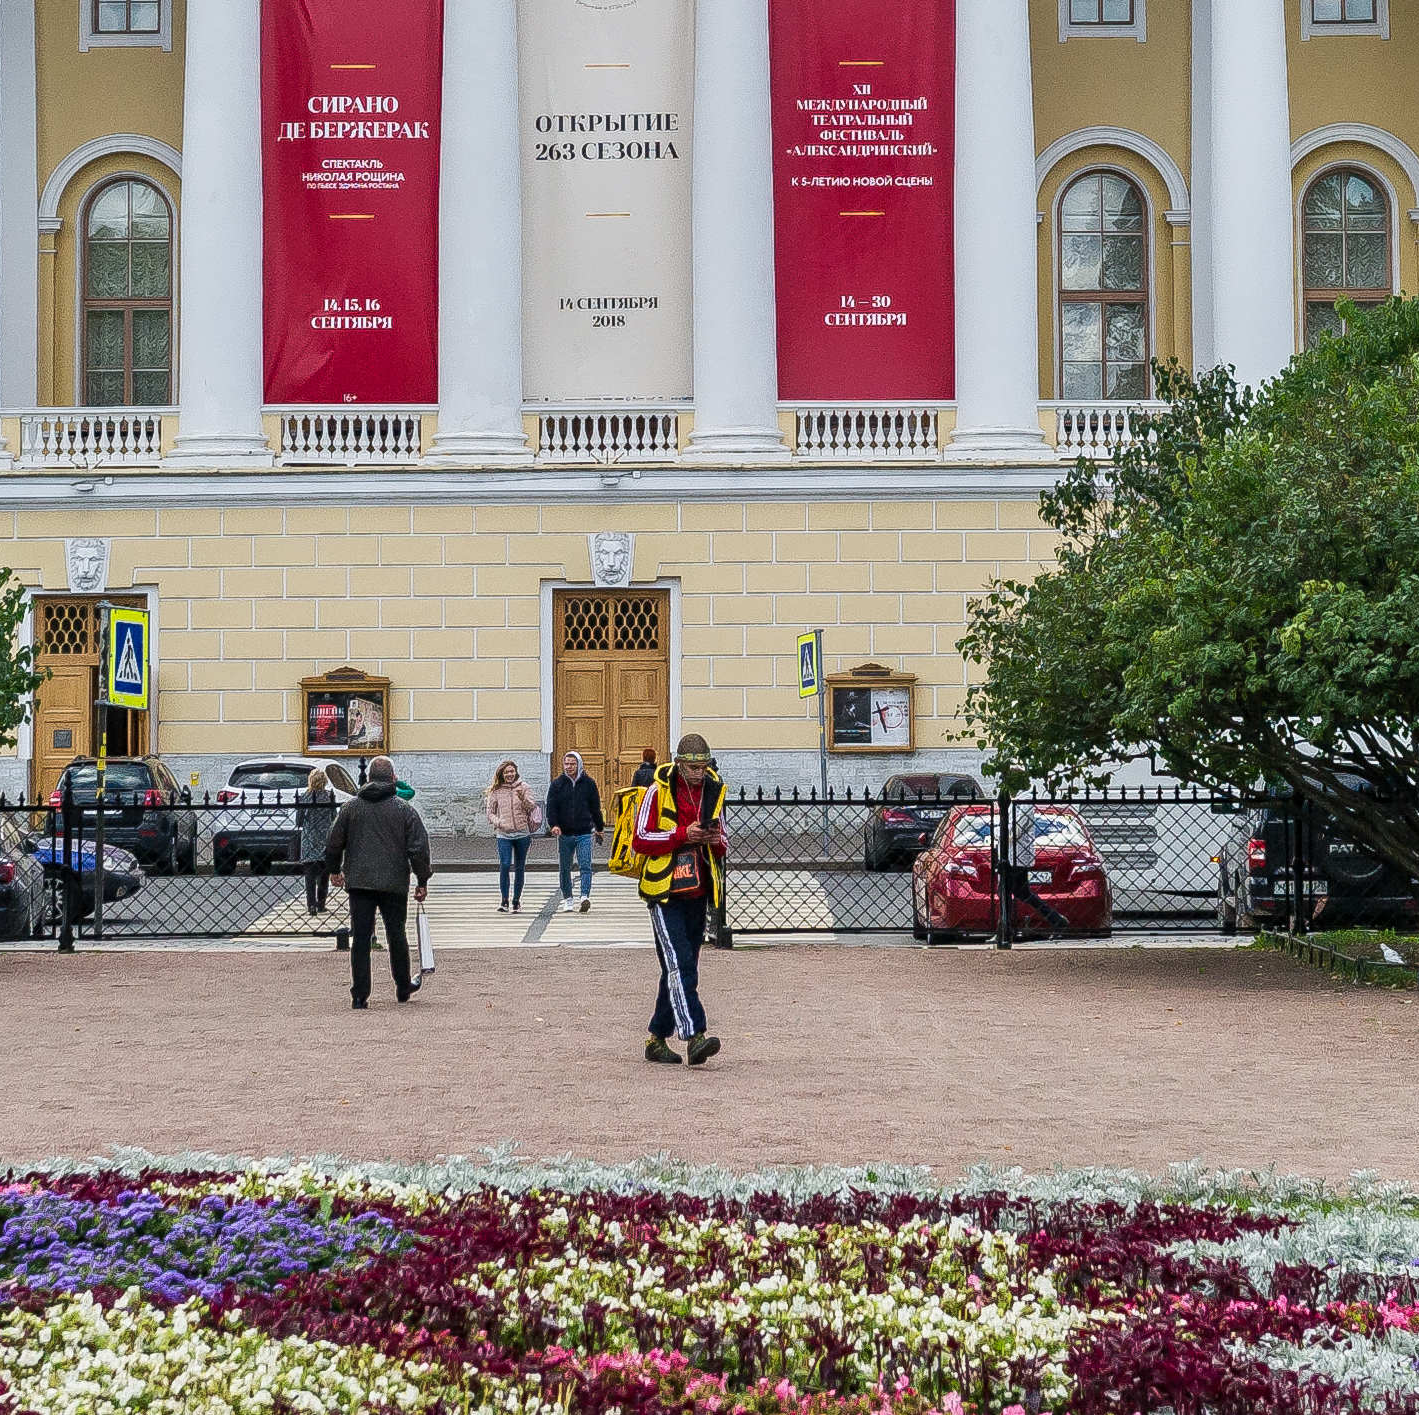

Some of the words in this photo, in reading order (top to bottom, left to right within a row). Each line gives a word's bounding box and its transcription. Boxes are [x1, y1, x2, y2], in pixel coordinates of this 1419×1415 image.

[307, 96, 400, 114] СИРАНО
[795, 97, 929, 112] МЕЖДУНАРОДНЫЙ
[535, 113, 680, 133] ОТКРЫТИЕ
[810, 112, 913, 126] ТЕАТРАЛЬНЫЙ
[277, 122, 306, 143] ДЕ
[309, 121, 430, 139] БЕРЖЕРАК
[819, 129, 905, 141] ФЕСТИВАЛЬ
[535, 142, 577, 161] 263
[580, 141, 681, 160] СЕЗОНА
[785, 142, 938, 157] «АЛЕКСАНДРИНСКИЙ»
[321, 159, 384, 169] СПЕКТАКЛЬ
[302, 172, 354, 182] НИКОЛАЯ
[355, 172, 406, 184] РОЩИНА
[791, 177, 799, 187] К
[801, 176, 851, 187] 5-ЛЕТИЮ
[852, 175, 893, 187] НОВОЙ
[894, 176, 933, 188] СЦЕНЫ
[323, 298, 342, 312] 14,
[344, 298, 363, 312] 15,
[365, 298, 381, 311] 16
[559, 297, 574, 311] 14
[576, 296, 659, 310] СЕНТЯБРЯ
[840, 295, 856, 308] 14
[871, 295, 891, 308] 30
[311, 316, 393, 329] СЕНТЯБРЯ
[592, 315, 626, 328] 2018
[824, 312, 907, 326] СЕНТЯБРЯ
[343, 393, 358, 403] 16+
